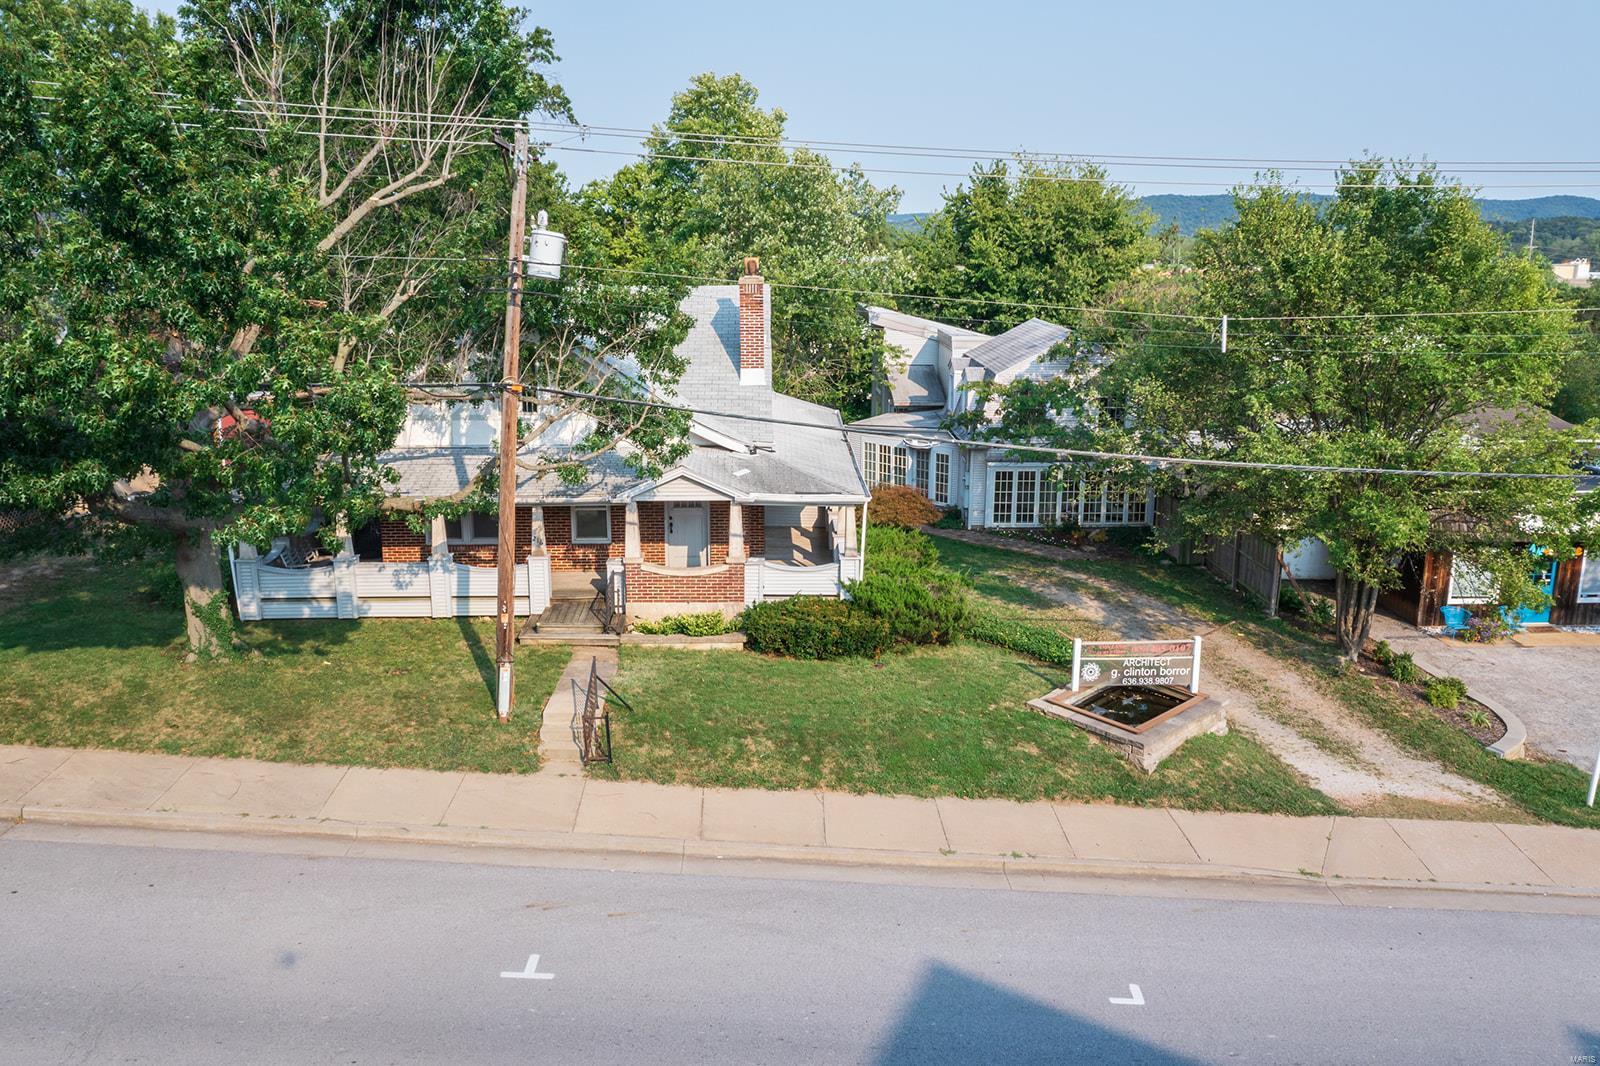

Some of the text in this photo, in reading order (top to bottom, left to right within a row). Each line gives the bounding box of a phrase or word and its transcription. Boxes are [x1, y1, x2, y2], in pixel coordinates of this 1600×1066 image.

[1122, 658, 1171, 667] ARCHITECT
[1111, 666, 1191, 679] g. clinton borror
[1122, 677, 1174, 685] 636.938.9807
